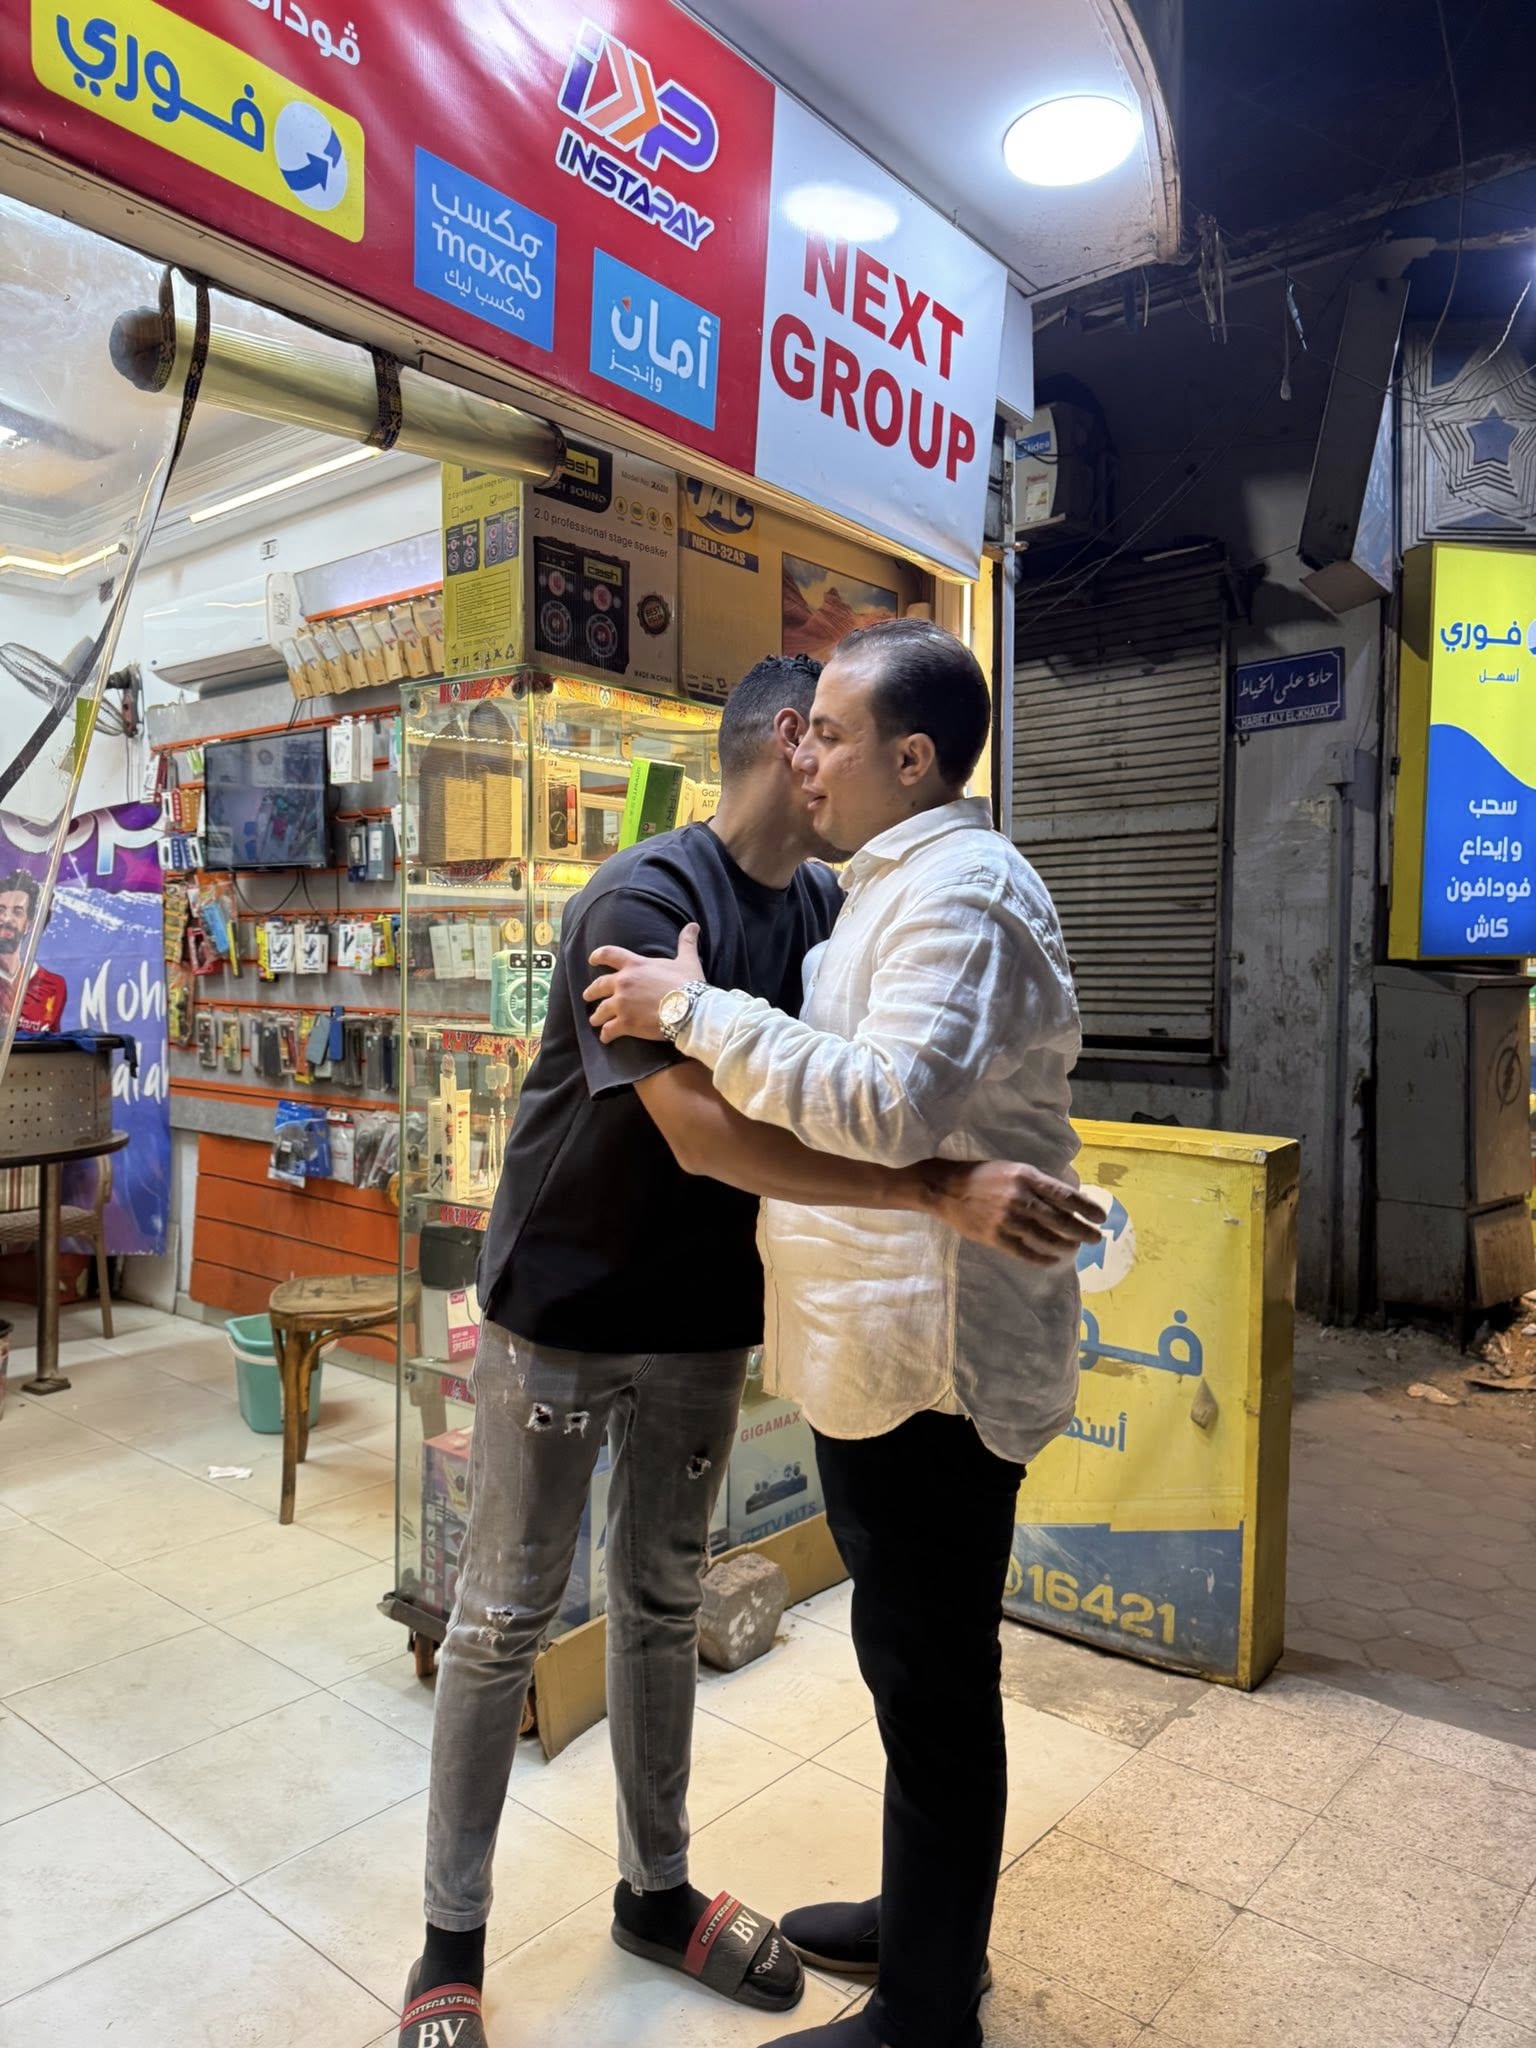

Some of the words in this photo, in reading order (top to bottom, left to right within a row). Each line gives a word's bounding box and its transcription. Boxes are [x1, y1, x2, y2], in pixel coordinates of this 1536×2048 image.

[56, 15, 265, 152] فوري
[557, 131, 712, 247] INSTAPAY
[432, 183, 543, 259] مكسب
[444, 269, 472, 298] ليك
[475, 286, 525, 321] مكسب
[803, 226, 964, 381] NEXT
[611, 296, 712, 389] أمان
[609, 349, 662, 393] وإنجز
[770, 313, 975, 482] GROUP
[569, 484, 607, 503] SOUND
[534, 508, 549, 522] 2.0
[551, 515, 607, 539] professional
[608, 532, 633, 548] stage
[634, 541, 668, 558] speaker
[1440, 620, 1522, 653] فوري
[634, 670, 649, 680] MADE
[656, 674, 672, 683] CHINA
[1239, 672, 1274, 700] الخياط
[1469, 799, 1517, 819] سحب
[1460, 836, 1522, 865] وإيداع
[1446, 876, 1531, 903] فودافون
[1466, 914, 1509, 943] كاش
[80, 959, 166, 1033] Moh
[740, 1410, 800, 1443] GIGAMAX
[784, 1502, 818, 1526] KITS
[1028, 1564, 1176, 1644] 16421
[728, 1910, 760, 1945] BV
[418, 2018, 467, 2048] BV
